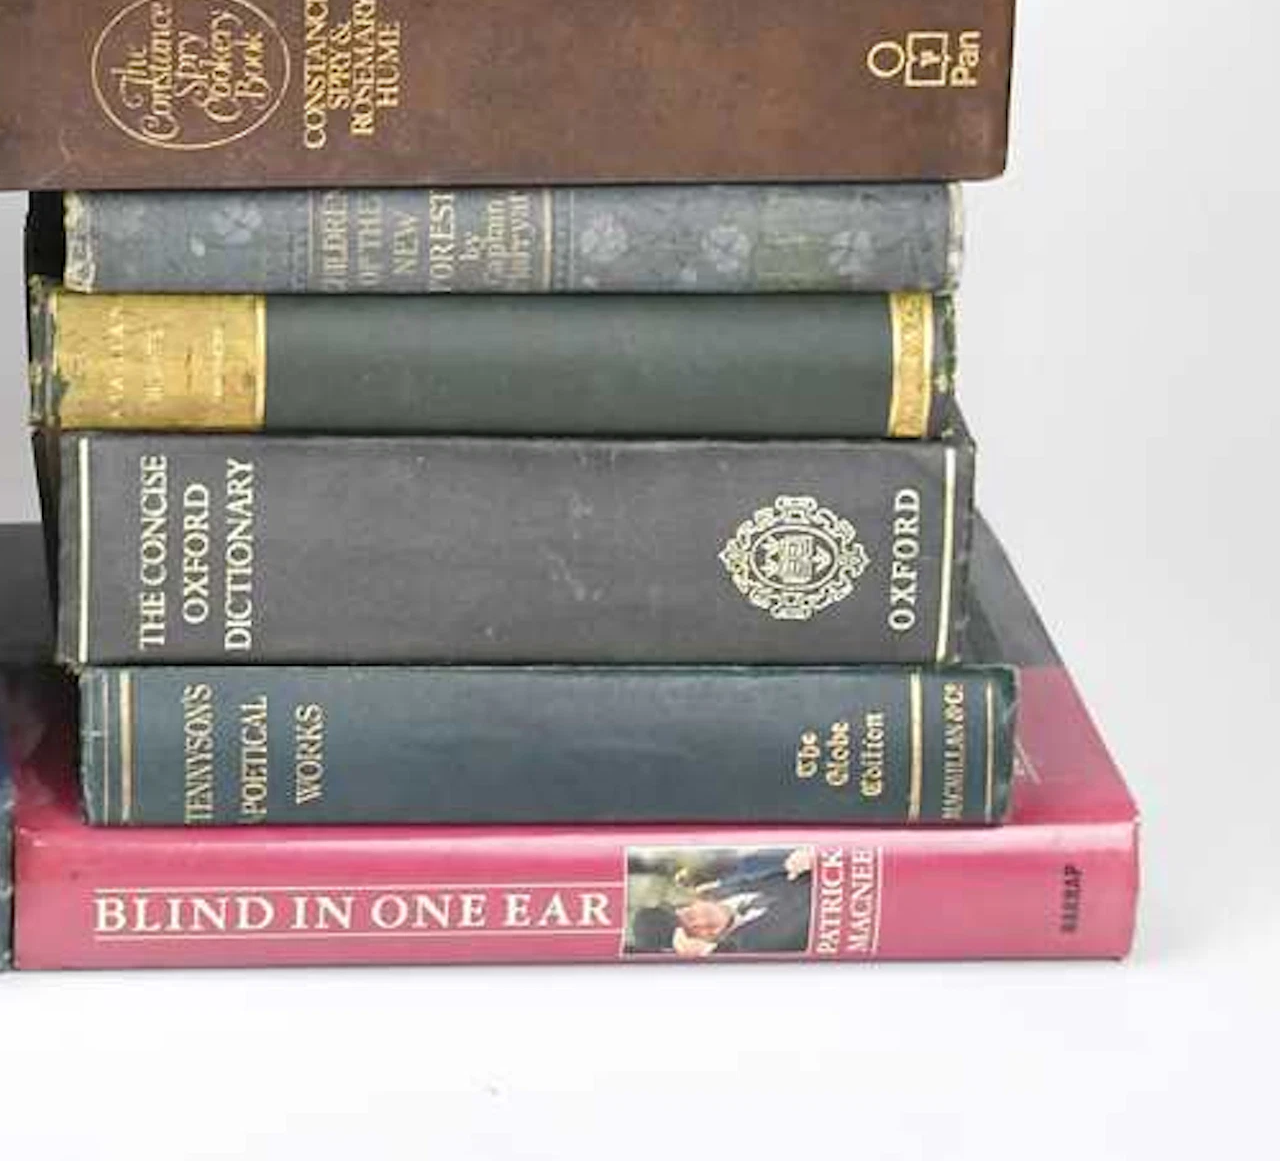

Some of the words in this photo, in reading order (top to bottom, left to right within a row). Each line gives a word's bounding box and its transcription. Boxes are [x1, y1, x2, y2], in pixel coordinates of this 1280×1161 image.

[174, 29, 211, 101] Spry
[233, 30, 273, 111] Book
[327, 20, 351, 44] &
[376, 21, 402, 108] HUME
[949, 29, 982, 88] Pan
[109, 41, 153, 111] The
[326, 49, 353, 111] SPRY
[394, 210, 419, 276] NEW
[139, 454, 169, 587] CONCISE
[182, 482, 210, 625] OXFORD
[224, 458, 254, 652] DICTIONARY
[887, 488, 921, 632] OXFORD
[138, 591, 166, 651] THE
[240, 695, 268, 816] POETICAL
[294, 702, 325, 806] WORKS
[825, 720, 850, 787] Globe
[92, 895, 275, 933] BLIND
[287, 895, 356, 930] IN
[369, 893, 487, 929] ONE
[503, 891, 613, 928] EAR
[816, 847, 844, 957] PATRICK
[847, 849, 875, 954] MACNEE
